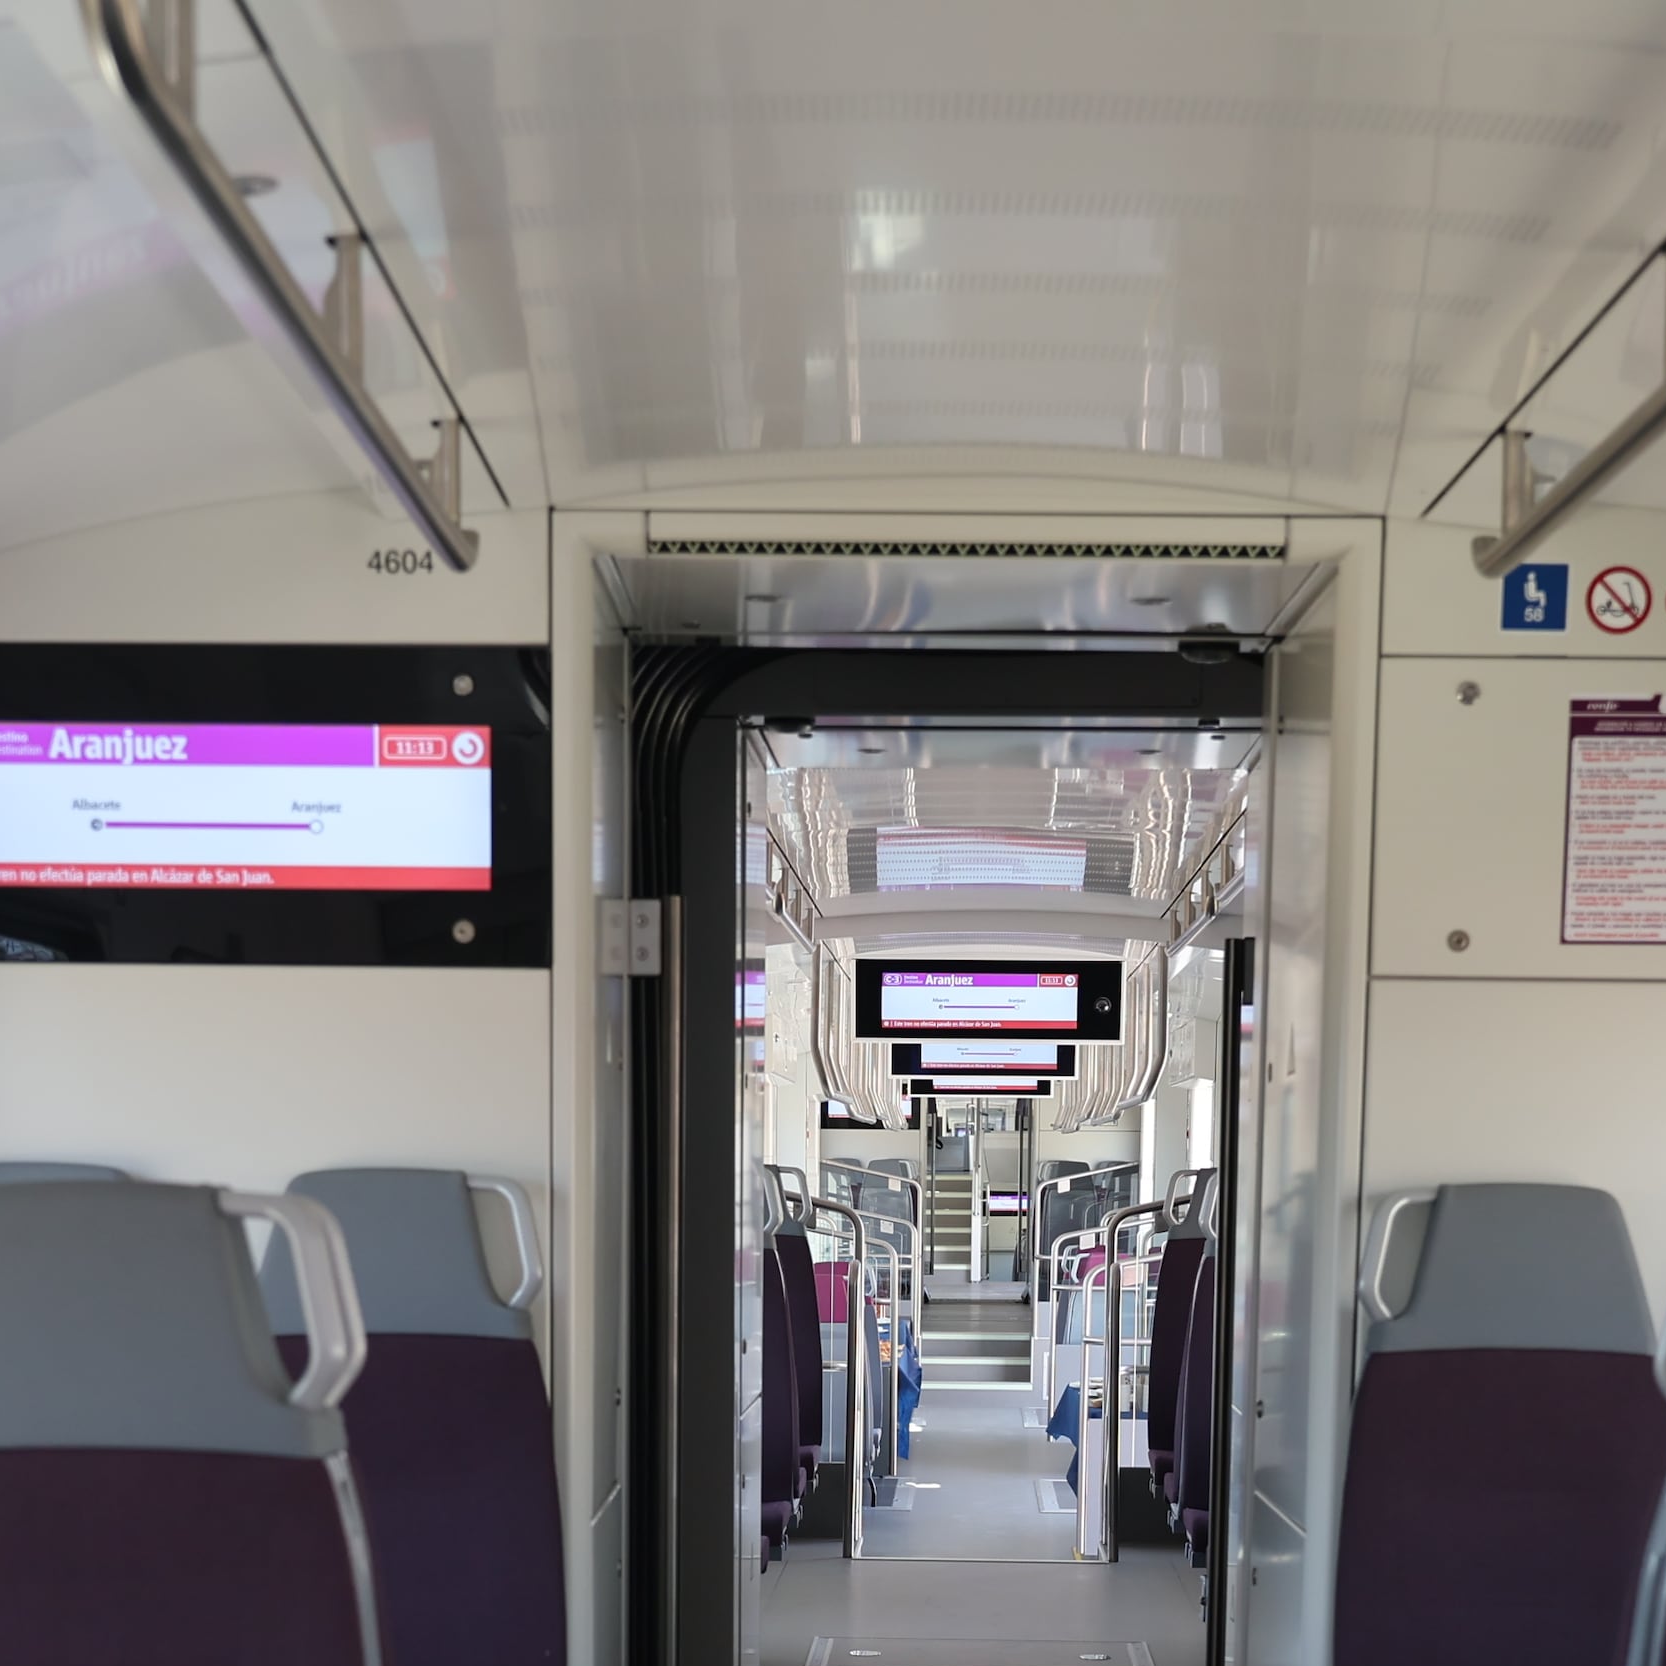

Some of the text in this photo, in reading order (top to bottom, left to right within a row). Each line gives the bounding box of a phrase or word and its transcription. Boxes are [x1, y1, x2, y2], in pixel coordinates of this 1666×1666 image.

[366, 549, 434, 574] 4604
[48, 727, 189, 765] Aranjuez
[291, 800, 342, 815] Aranjuez
[21, 870, 38, 881] no
[40, 867, 83, 882] efectúa
[87, 867, 129, 887] parada
[133, 871, 148, 882] en
[151, 867, 193, 883] Alcázar
[197, 868, 213, 883] de
[216, 869, 239, 884] San
[925, 973, 974, 987] Aranjuez
